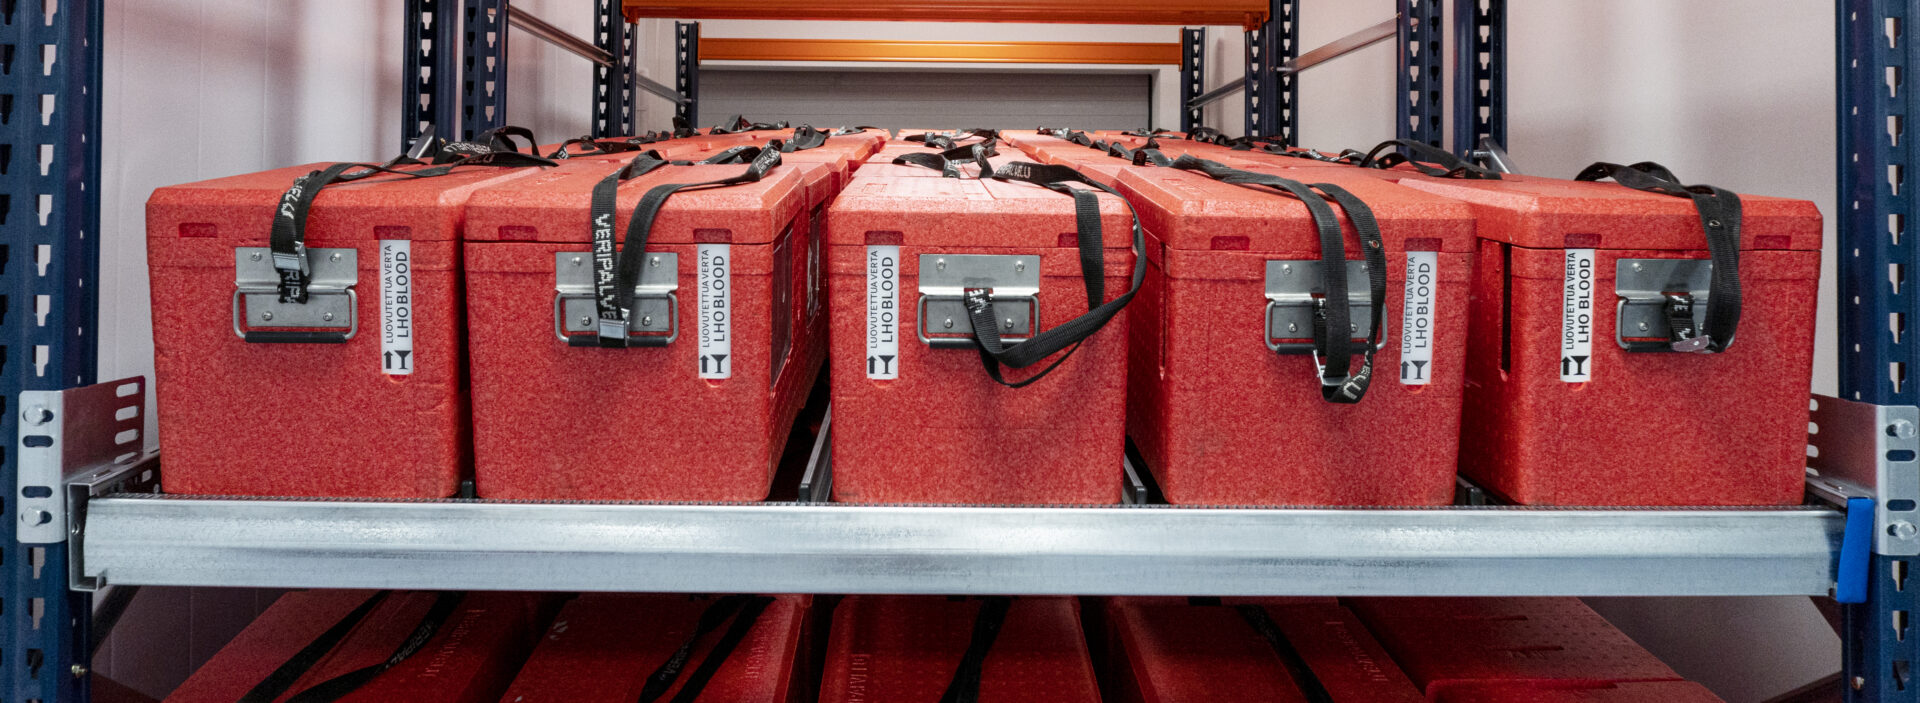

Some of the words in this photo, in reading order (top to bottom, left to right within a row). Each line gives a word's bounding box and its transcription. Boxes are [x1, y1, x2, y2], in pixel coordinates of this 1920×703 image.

[384, 245, 392, 274] VERTA
[1406, 257, 1416, 285] VERTA
[1567, 253, 1576, 281] VERTA
[1578, 259, 1590, 309] BLOOD
[1404, 288, 1414, 354] LUOVUTETTUA
[1566, 285, 1575, 350] LUOVUTETTUA
[1577, 314, 1589, 343] LHO
